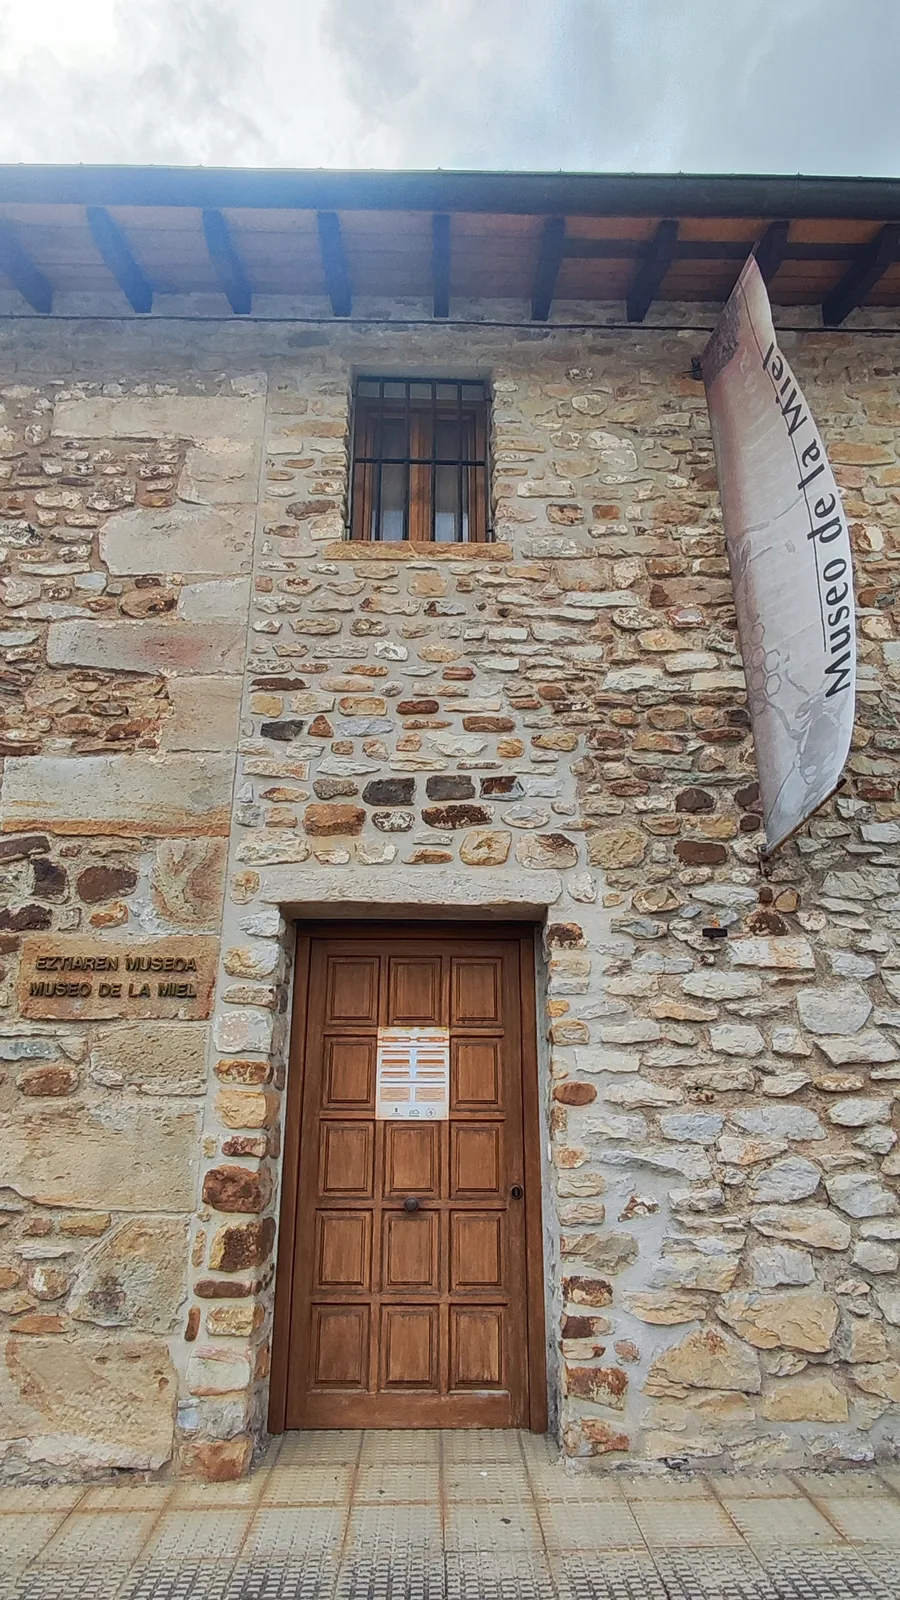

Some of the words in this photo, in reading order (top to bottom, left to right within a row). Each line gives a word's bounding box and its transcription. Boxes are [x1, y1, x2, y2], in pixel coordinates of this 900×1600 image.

[763, 341, 808, 437] Miel
[798, 438, 825, 490] la
[807, 492, 843, 543] de
[823, 557, 852, 698] Museo
[35, 955, 119, 971] EZTIAREN
[125, 955, 197, 972] MUSEOA
[29, 982, 92, 998] MUSEO
[98, 982, 122, 998] DE
[129, 982, 150, 998] LA
[157, 982, 197, 998] MIEL
